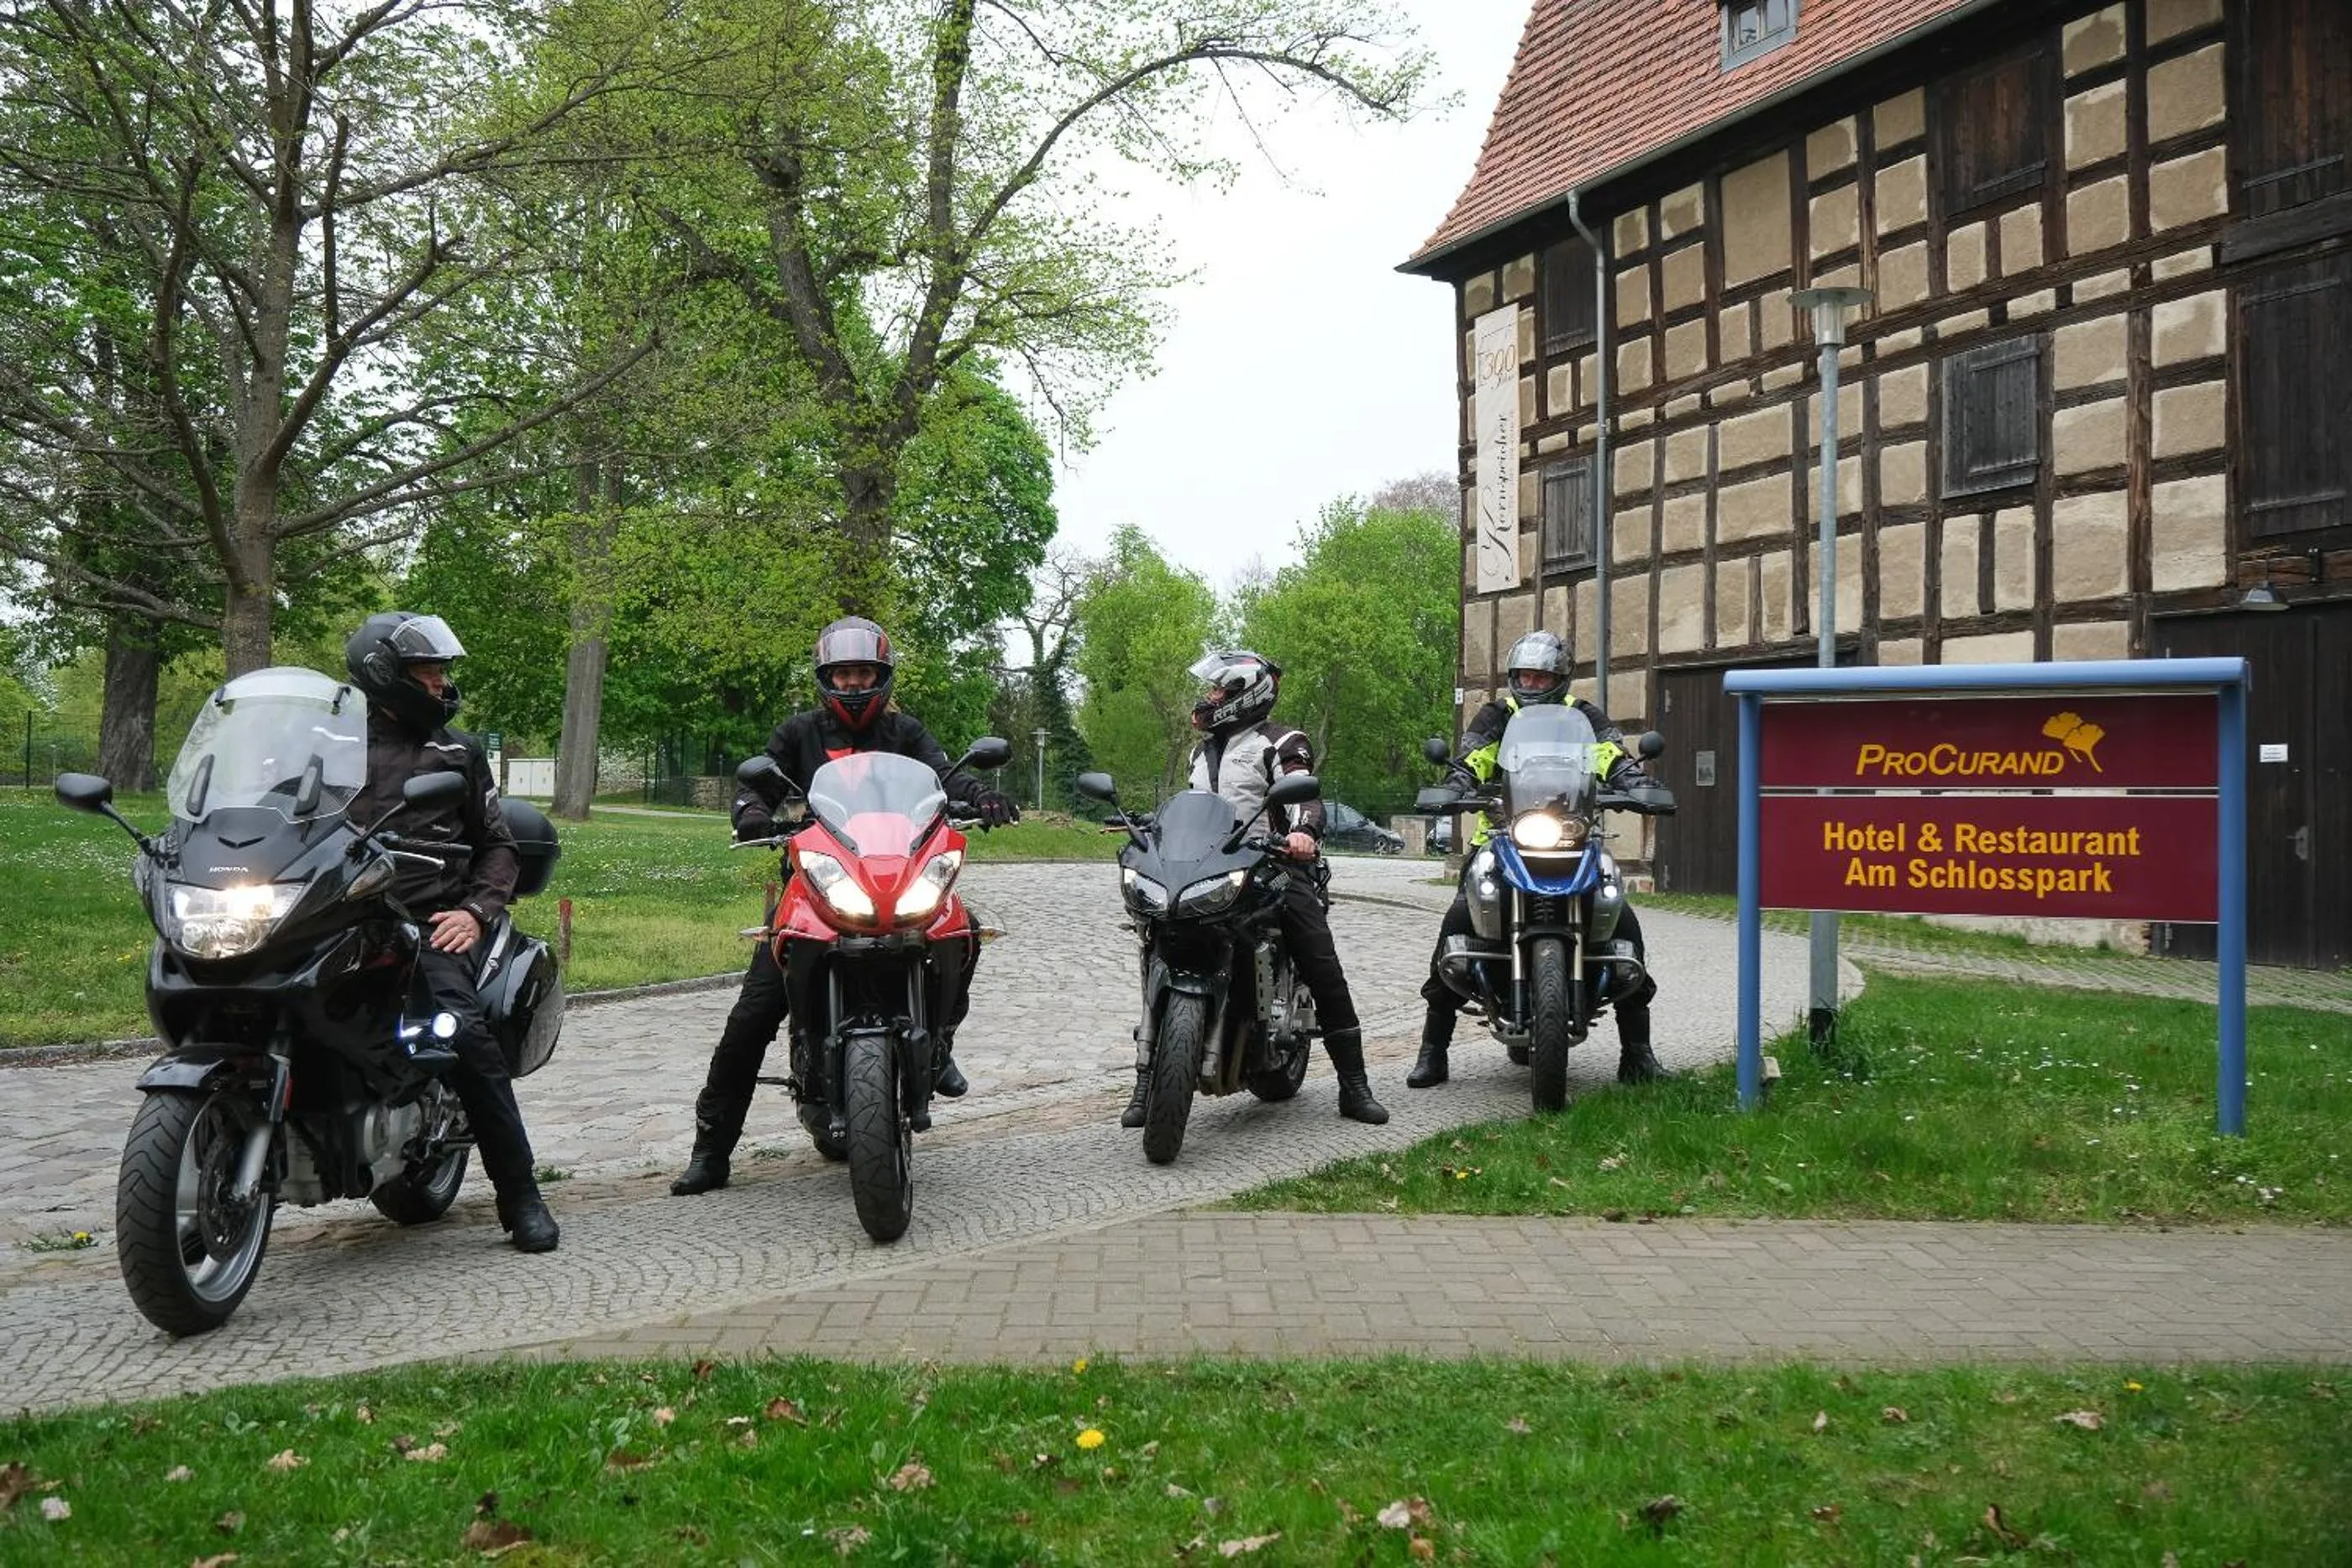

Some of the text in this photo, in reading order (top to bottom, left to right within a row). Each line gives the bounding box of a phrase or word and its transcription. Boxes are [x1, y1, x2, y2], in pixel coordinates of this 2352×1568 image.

[1824, 821, 2141, 856] Hotel & Restaurant
[1845, 857, 2113, 899] Am Schlosspark
